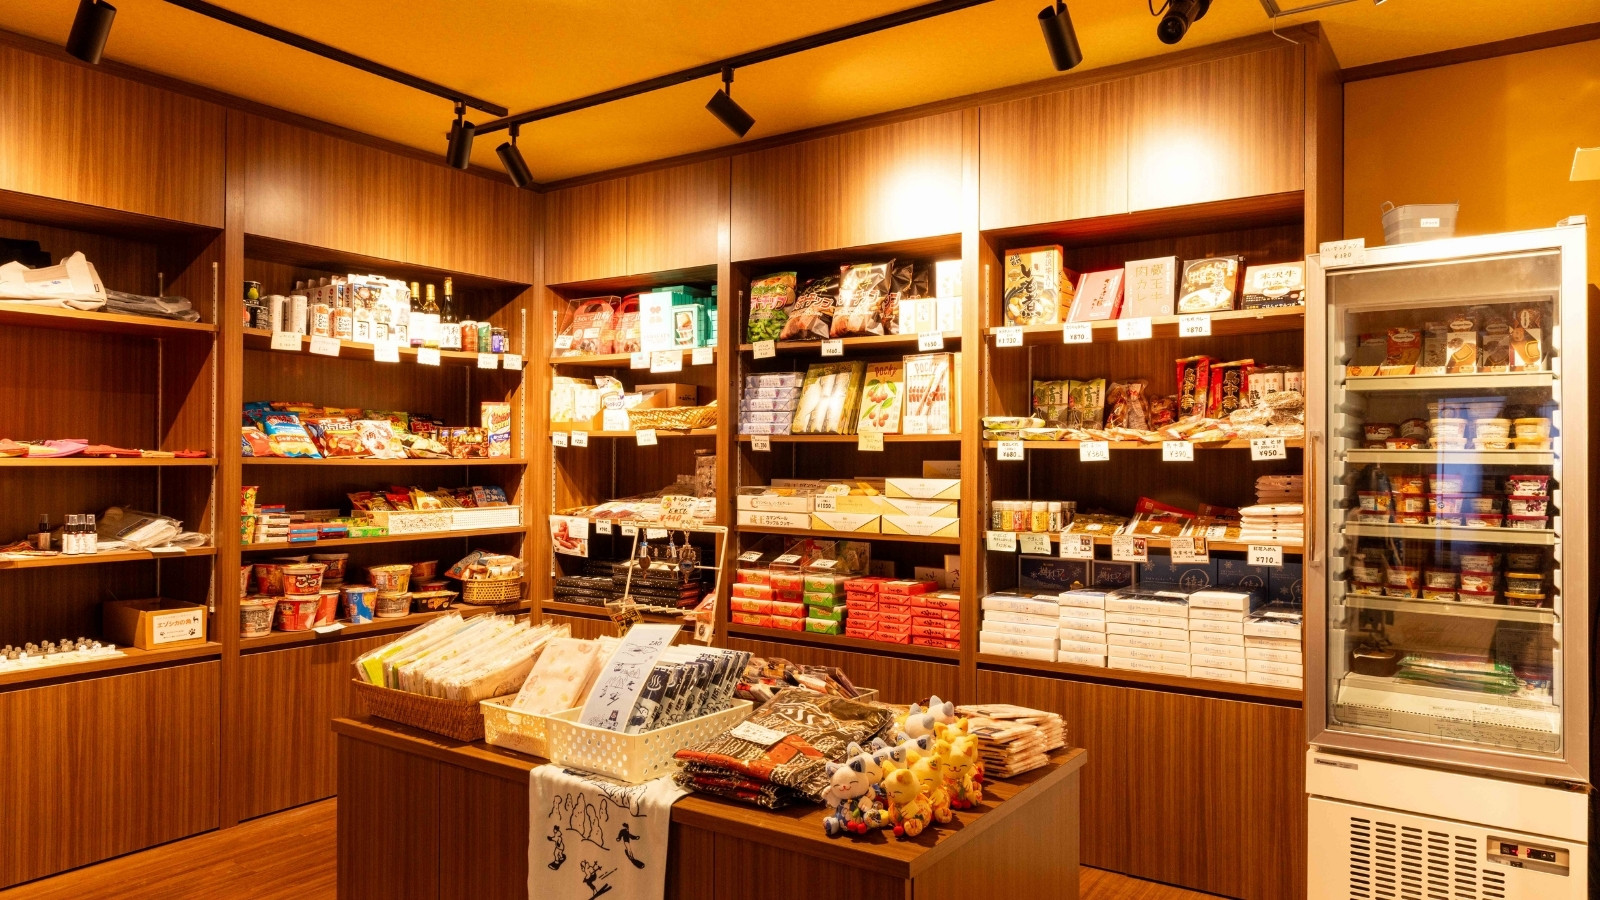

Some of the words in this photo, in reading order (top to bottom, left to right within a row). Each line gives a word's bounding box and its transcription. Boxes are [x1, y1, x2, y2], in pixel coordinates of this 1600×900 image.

[1260, 269, 1297, 280] 米沢牛
[1151, 264, 1164, 304] 蔵王牛
[1255, 556, 1274, 564] ¥710
